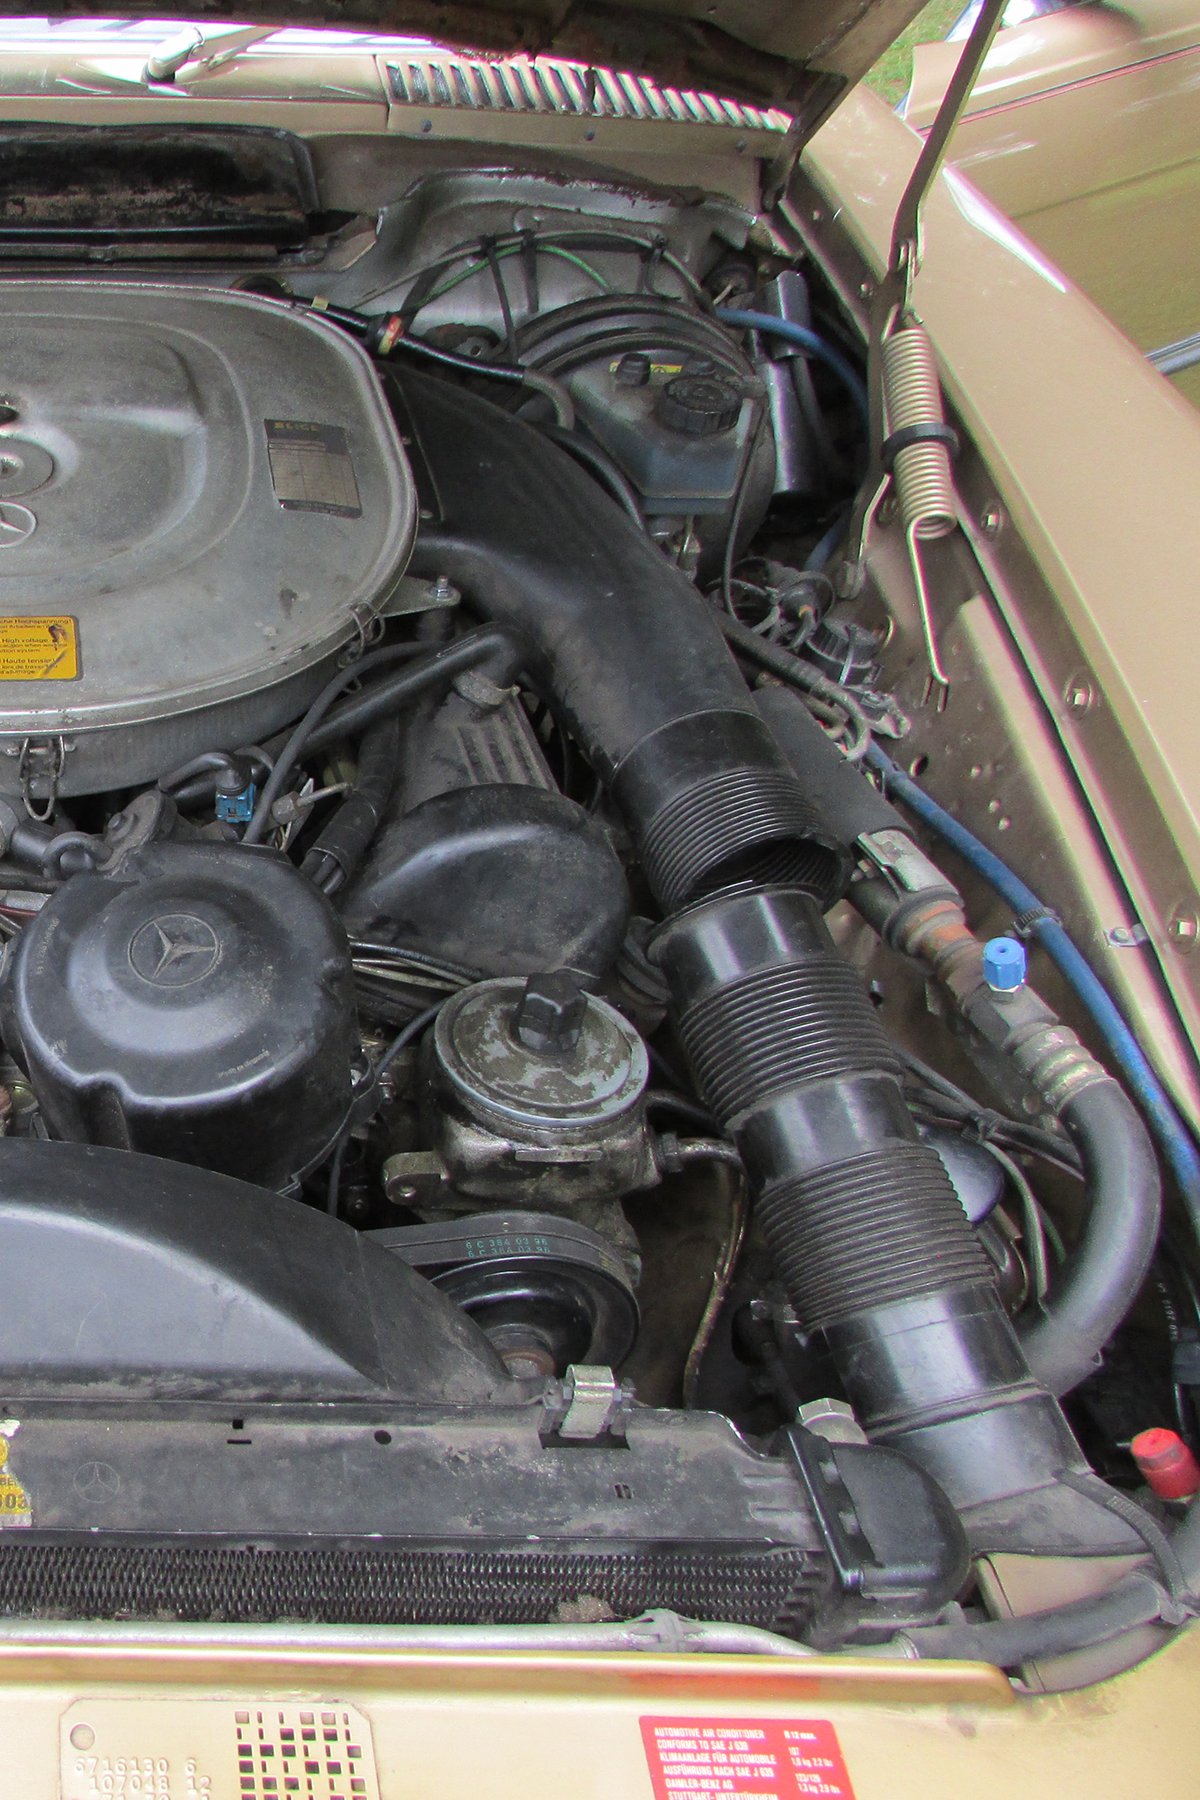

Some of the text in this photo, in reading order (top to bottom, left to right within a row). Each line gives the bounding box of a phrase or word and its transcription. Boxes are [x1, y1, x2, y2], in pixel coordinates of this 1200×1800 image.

[654, 1727, 766, 1739] AUTOMOTIVE AIR CONDITIONER
[657, 1739, 697, 1750] CONFORMS
[699, 1740, 709, 1750] TO
[710, 1740, 726, 1750] SAE
[659, 1751, 776, 1765] KLIMAANLAGE FÜR AUTOMOBILE
[185, 1757, 197, 1776] 6
[663, 1764, 712, 1776] AUSFÜHRUNG
[713, 1766, 735, 1777] NACH
[736, 1767, 752, 1777] SAE
[665, 1778, 734, 1790] DAIMLER-BENZ AG
